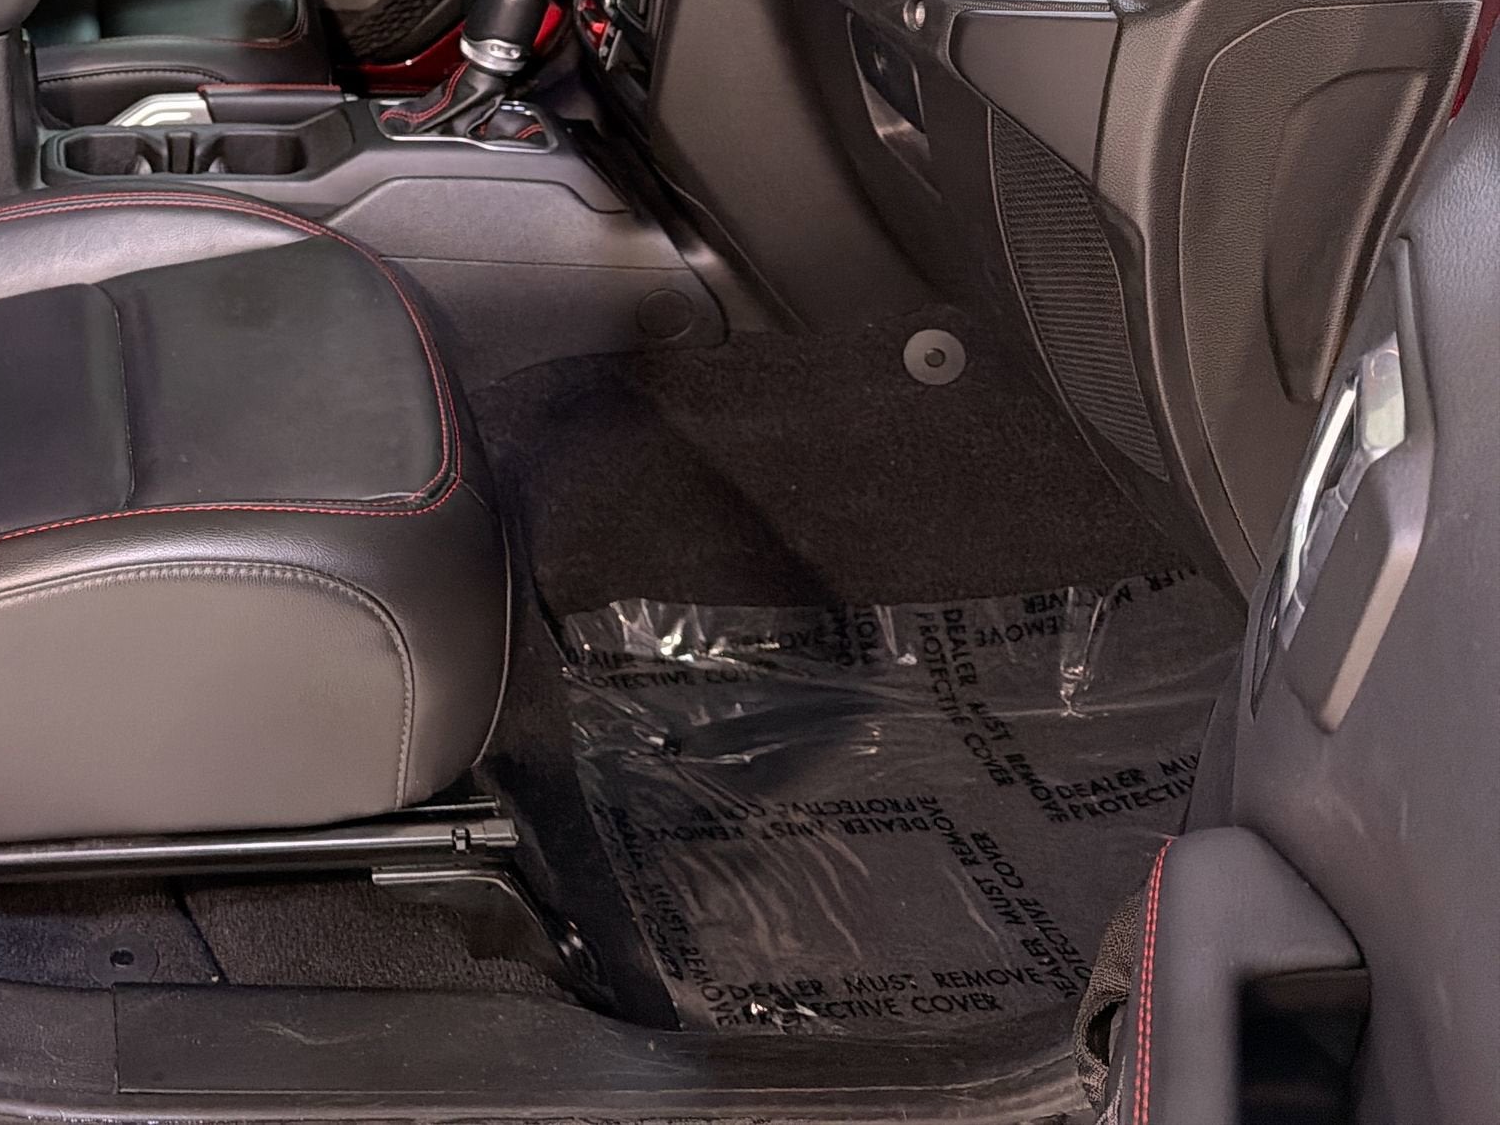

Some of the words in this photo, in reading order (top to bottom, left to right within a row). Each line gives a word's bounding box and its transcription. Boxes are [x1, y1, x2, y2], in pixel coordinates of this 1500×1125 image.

[969, 830, 1025, 889] COVER
[1013, 896, 1094, 980] OTECTIVE
[930, 965, 1046, 989] REMOVE
[910, 992, 1004, 1013] COVER
